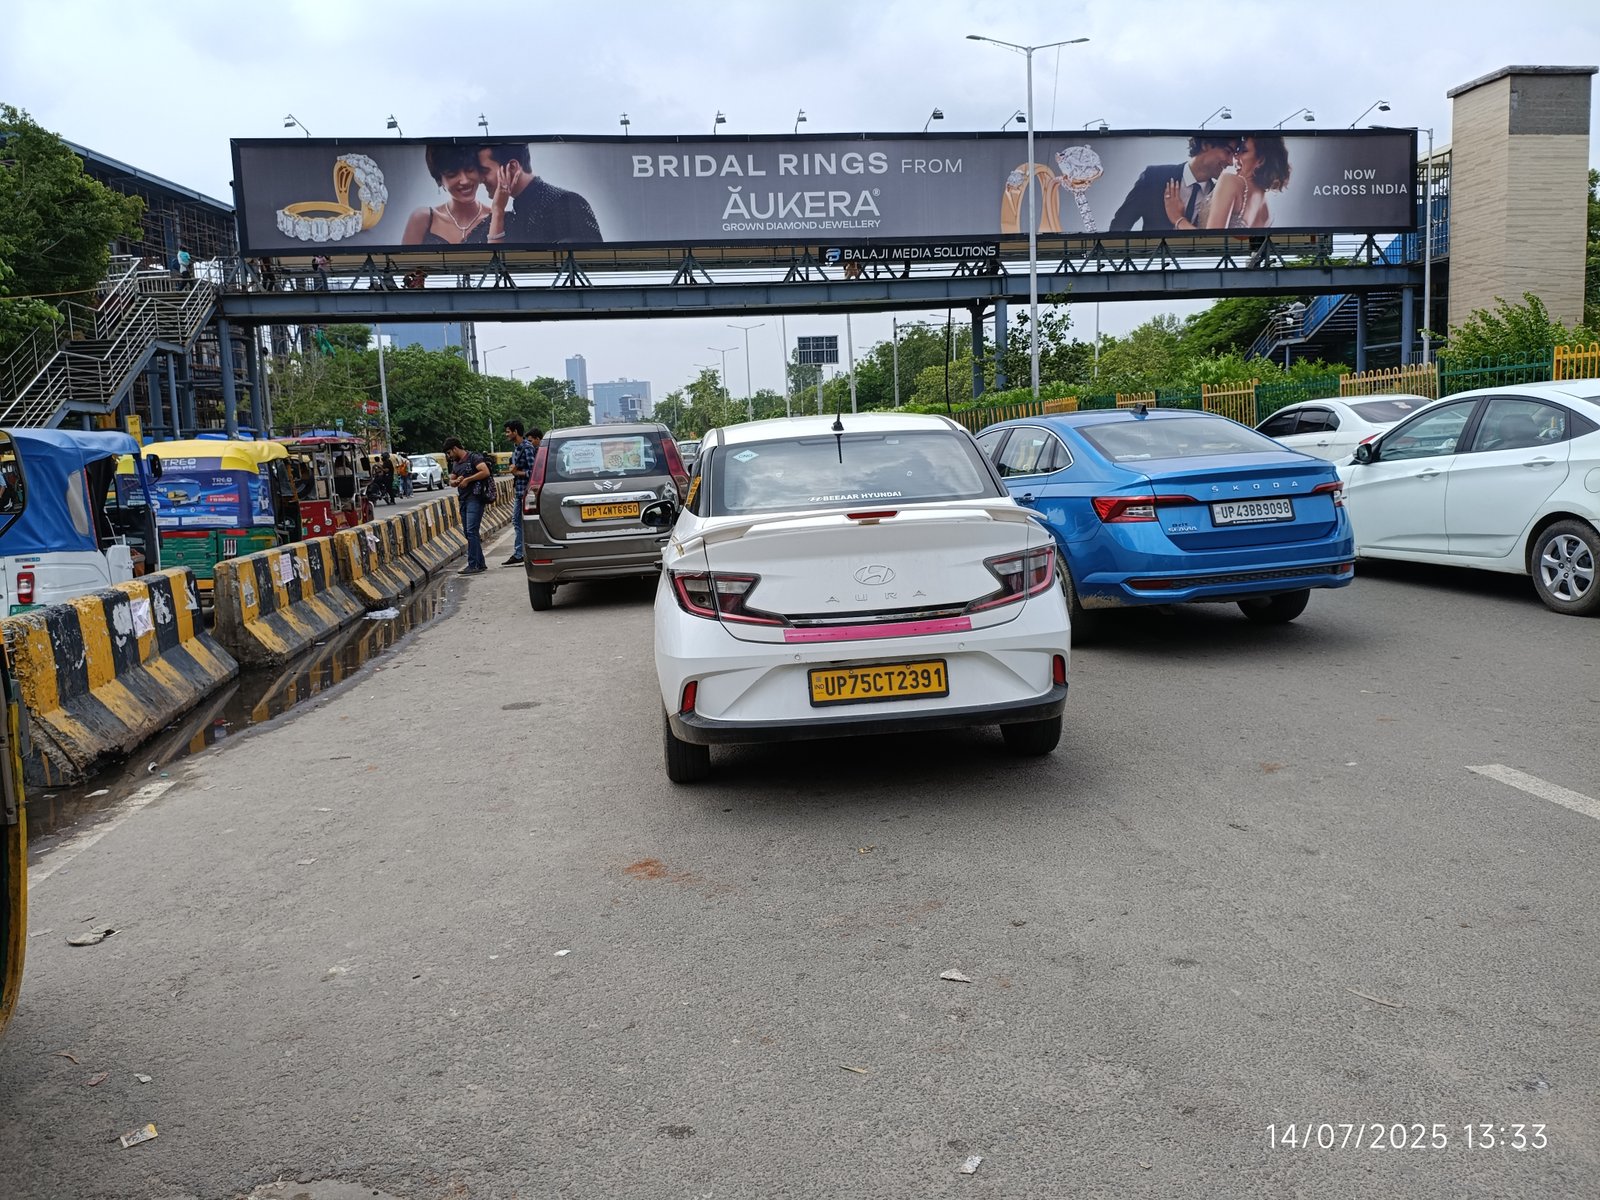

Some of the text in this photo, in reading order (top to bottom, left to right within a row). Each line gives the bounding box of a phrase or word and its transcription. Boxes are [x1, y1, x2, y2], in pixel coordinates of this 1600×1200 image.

[632, 152, 962, 177] BRIDAL RINGS FROM
[1344, 169, 1376, 180] NOW
[1313, 183, 1408, 196] ACROSS INDIA
[722, 219, 881, 231] GROWN DIAMOND JEWELLERY
[844, 245, 996, 259] BALAJI MEDIA SOLUTIONS
[1211, 481, 1298, 492] SKODA
[822, 490, 902, 501] BEEAAR HYUNDAI
[1220, 501, 1290, 519] UP43BB9098
[825, 590, 927, 603] AURA
[825, 668, 942, 696] UP75CT2391
